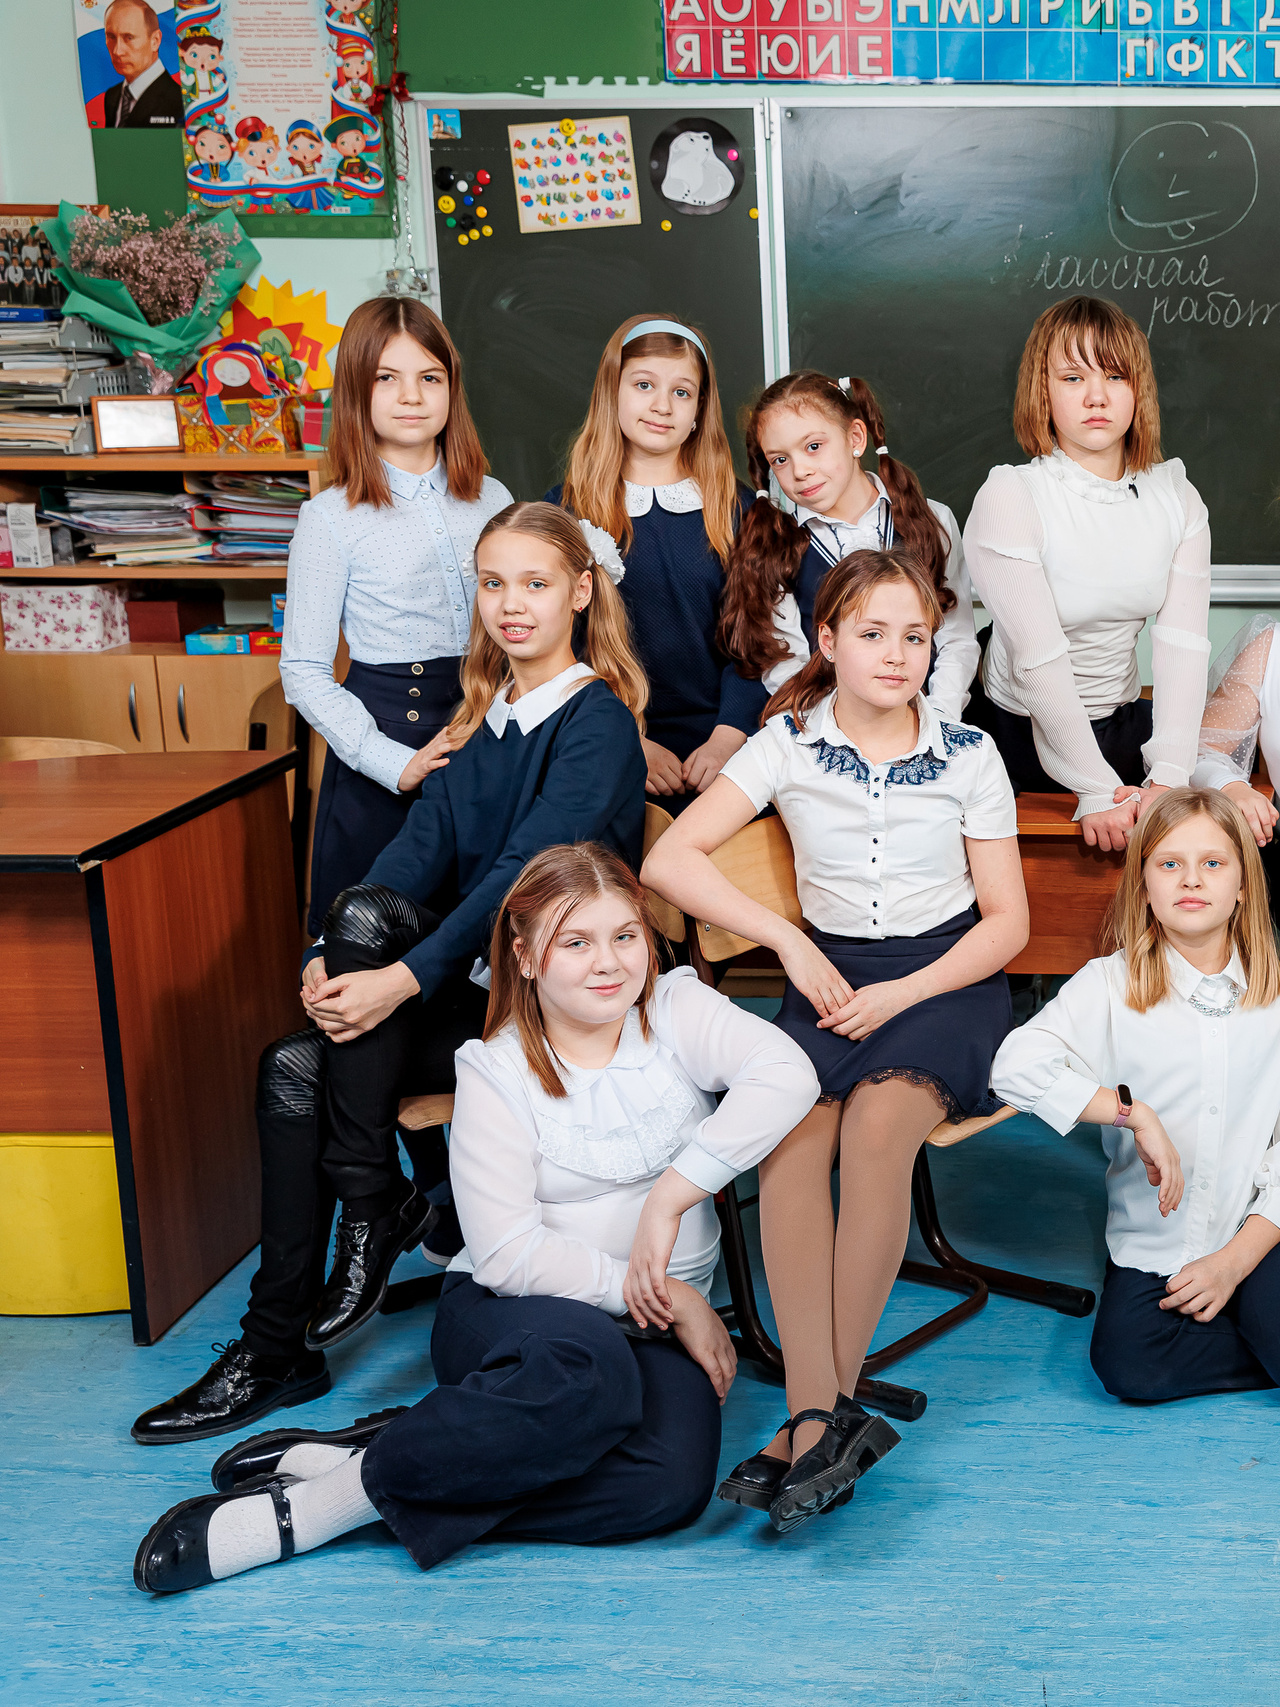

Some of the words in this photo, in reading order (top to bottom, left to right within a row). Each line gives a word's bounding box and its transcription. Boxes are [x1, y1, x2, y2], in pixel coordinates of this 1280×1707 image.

[675, 33, 702, 73] Я
[721, 28, 746, 74] Ё
[760, 33, 800, 75] Ю
[807, 34, 841, 75] И
[857, 35, 884, 75] Е
[1126, 38, 1155, 77] П
[1166, 38, 1205, 77] Ф
[1218, 39, 1248, 78] К
